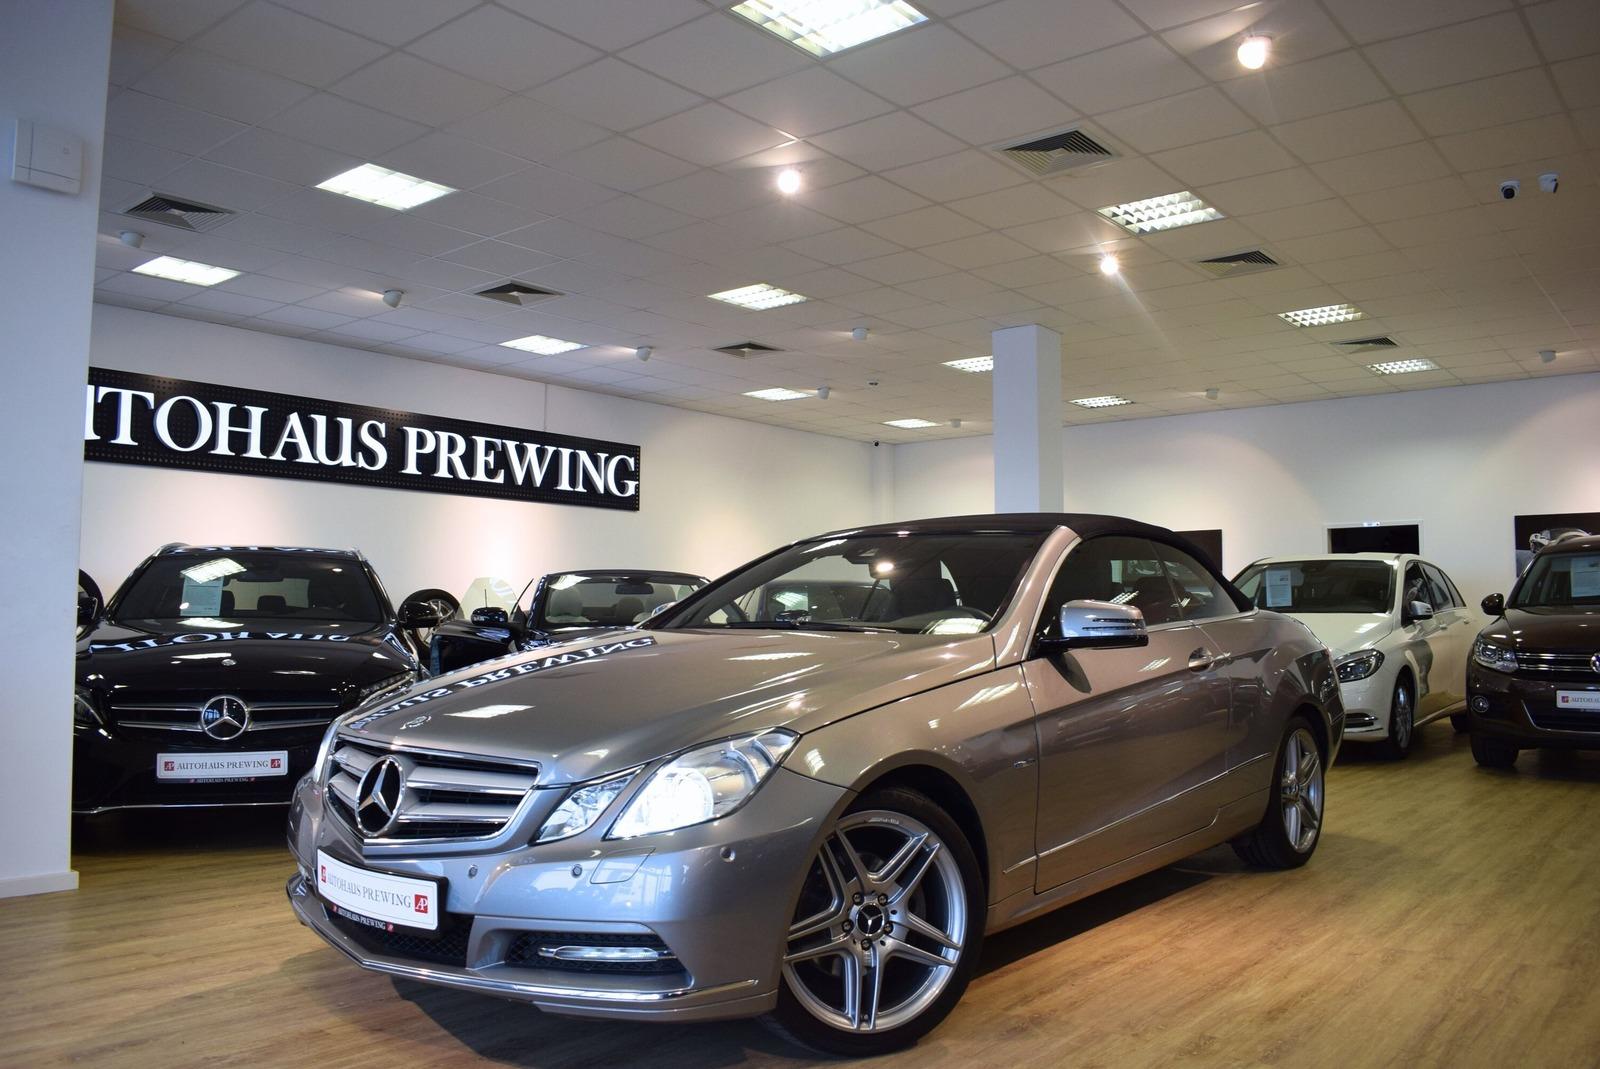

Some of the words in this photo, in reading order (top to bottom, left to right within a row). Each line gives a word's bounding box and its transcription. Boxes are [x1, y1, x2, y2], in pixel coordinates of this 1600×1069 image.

[401, 426, 636, 497] PREWING
[177, 761, 225, 770] AUTOHAUS
[226, 760, 269, 769] PREWING
[327, 872, 362, 897] AUTOHAUS
[362, 886, 412, 909] PREWING
